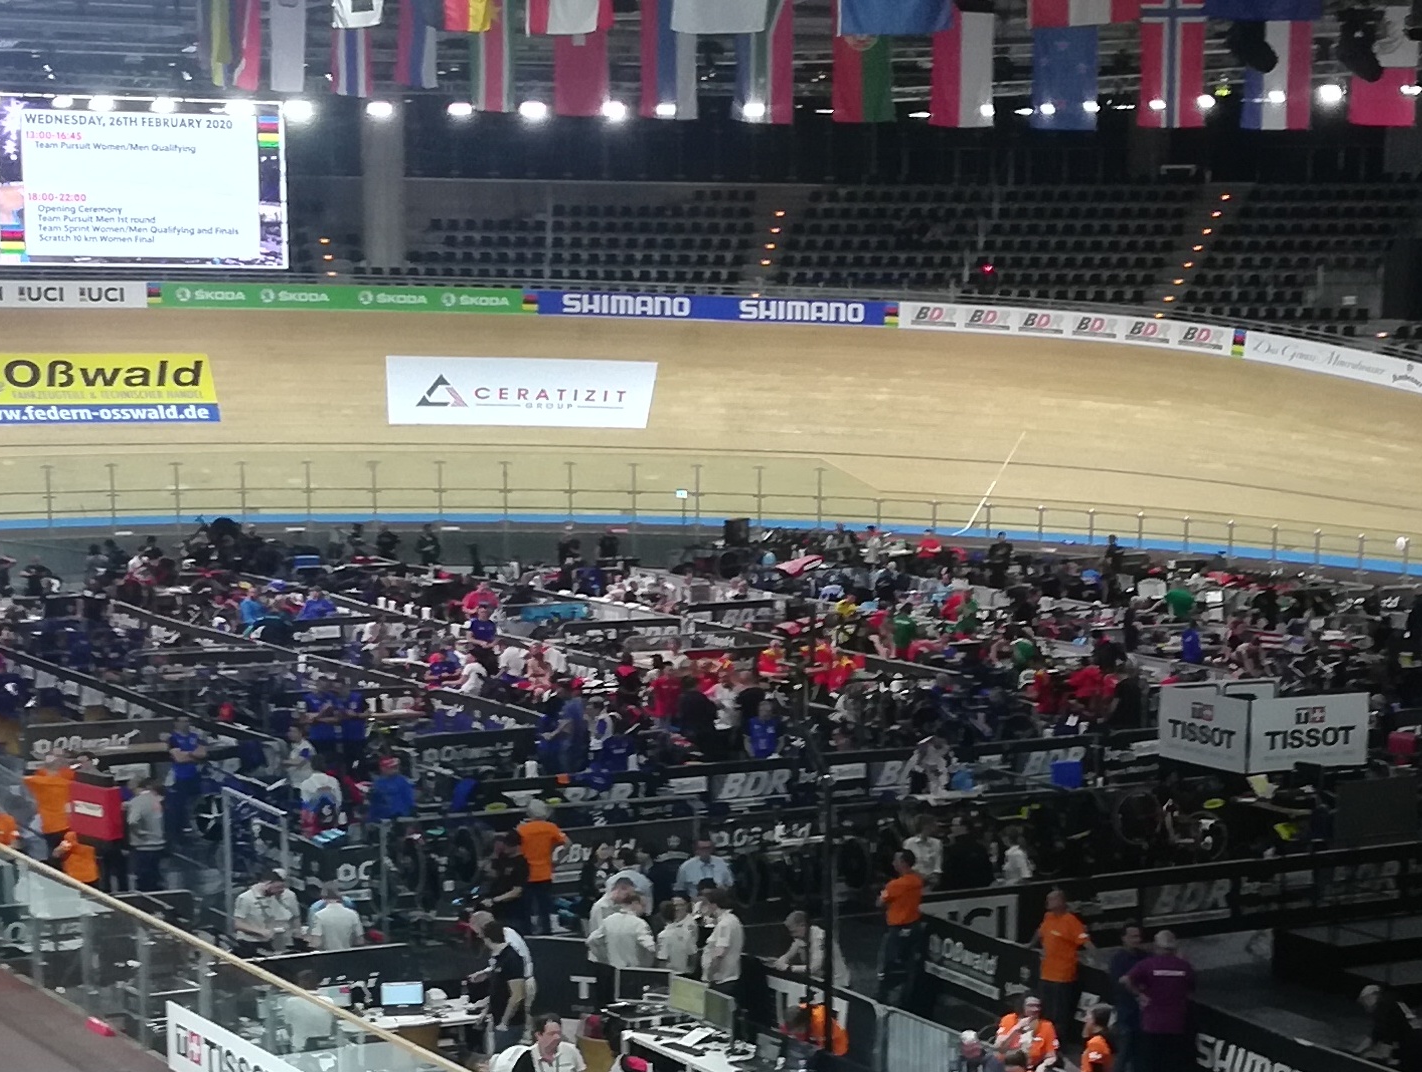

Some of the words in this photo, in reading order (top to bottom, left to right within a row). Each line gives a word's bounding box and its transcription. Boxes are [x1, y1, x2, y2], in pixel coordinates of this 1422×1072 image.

[25, 114, 106, 127] WEDNESDAY,
[109, 116, 138, 127] 26TH
[141, 117, 203, 128] FEBRUARY
[206, 119, 233, 129] 2020
[35, 141, 58, 149] Team
[60, 142, 91, 150] Pursuit
[93, 143, 149, 151] Women/Men
[151, 144, 196, 154] Qualifying
[28, 193, 87, 202] 18:00-22:00
[38, 205, 76, 214] Opening
[78, 206, 122, 215] Ceremony
[38, 214, 61, 223] Team
[63, 215, 93, 223] Pursuit
[95, 215, 115, 223] Men
[130, 216, 156, 224] round
[38, 224, 62, 233] Team
[64, 225, 90, 234] Sprint
[92, 225, 148, 234] Women/Men
[150, 226, 195, 236] Qualifying
[197, 227, 213, 235] and
[215, 227, 240, 236] Finals
[39, 234, 71, 243] Scratch
[83, 235, 98, 243] km
[99, 236, 132, 244] Women
[134, 236, 155, 244] Final
[26, 286, 65, 302] UCI
[87, 286, 125, 302] UCI
[562, 293, 691, 318] SHIMANO
[739, 299, 865, 324] SHIMANO
[4, 359, 205, 388] Oßwald
[474, 386, 628, 403] CERATIZIT
[524, 402, 574, 411] GROUP
[1167, 718, 1237, 749] TISSOT
[1264, 724, 1356, 750] TISSOT
[717, 768, 792, 800] BDR
